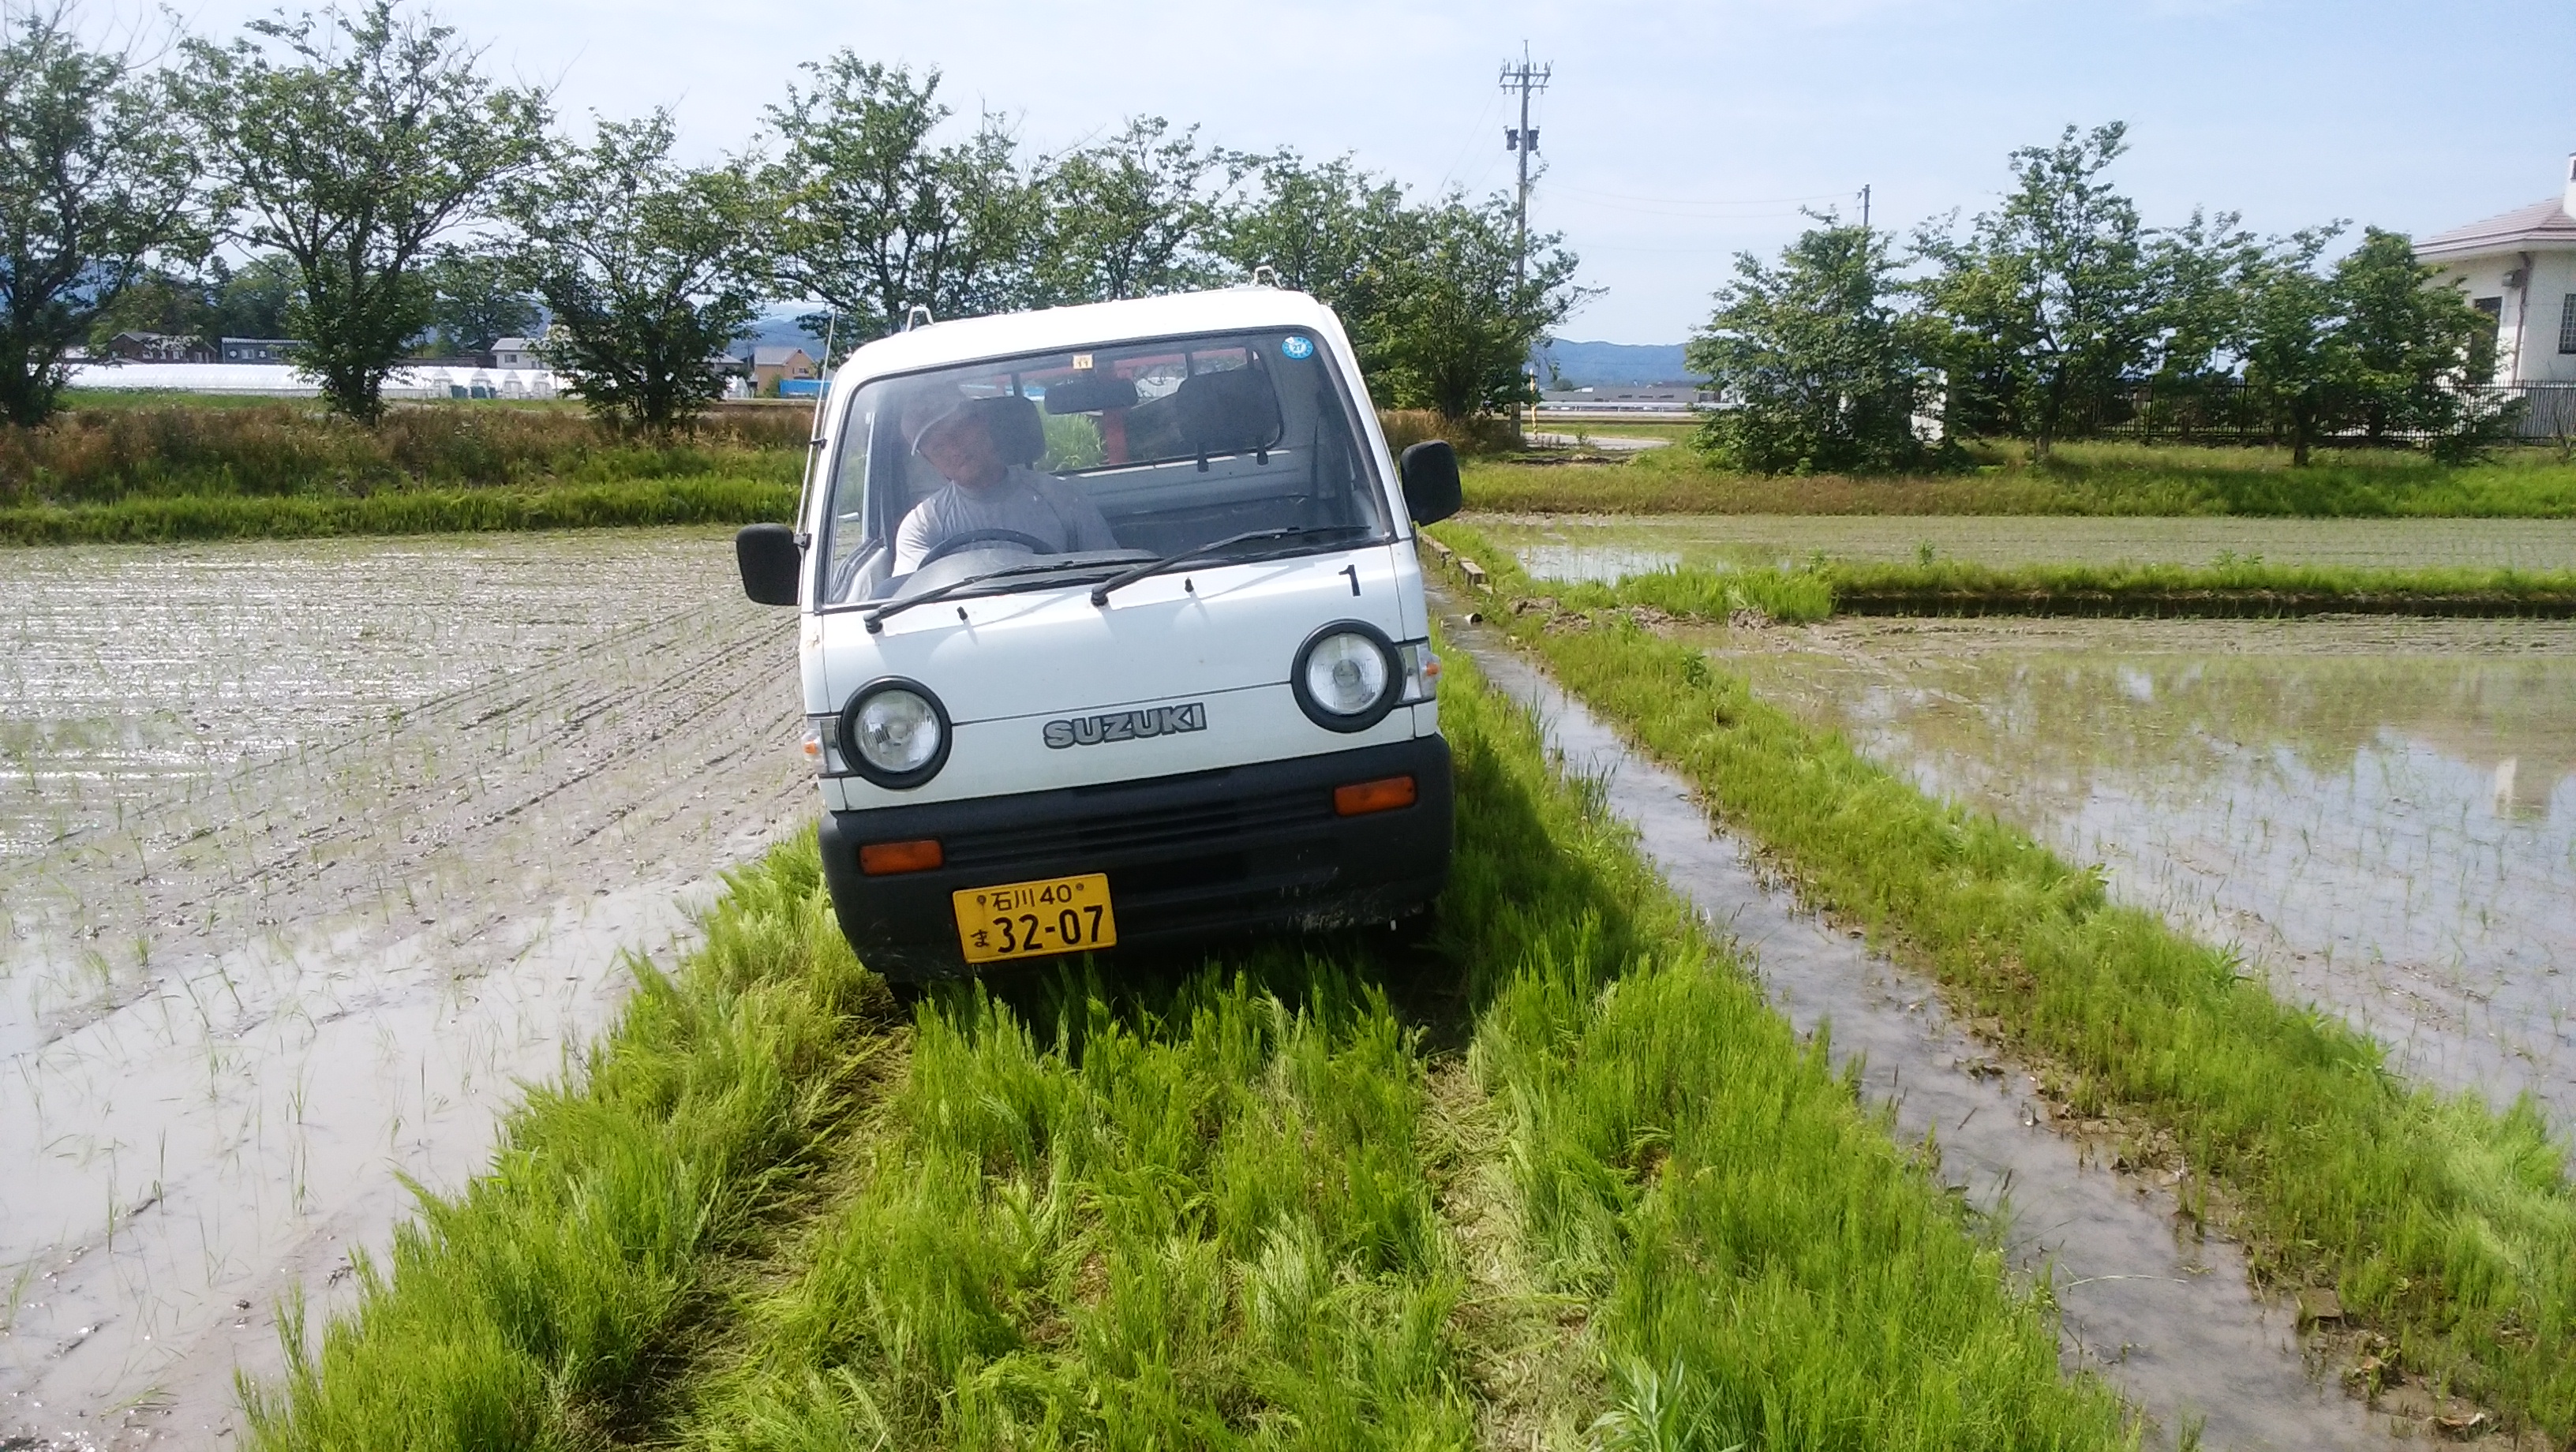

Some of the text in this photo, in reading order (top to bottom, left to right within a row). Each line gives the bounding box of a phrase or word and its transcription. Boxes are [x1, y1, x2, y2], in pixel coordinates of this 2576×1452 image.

[1338, 564, 1361, 597] 1
[1043, 702, 1208, 750] SUZUKI
[990, 884, 1072, 911] 石川 40
[970, 904, 1103, 953] ま 32-07
